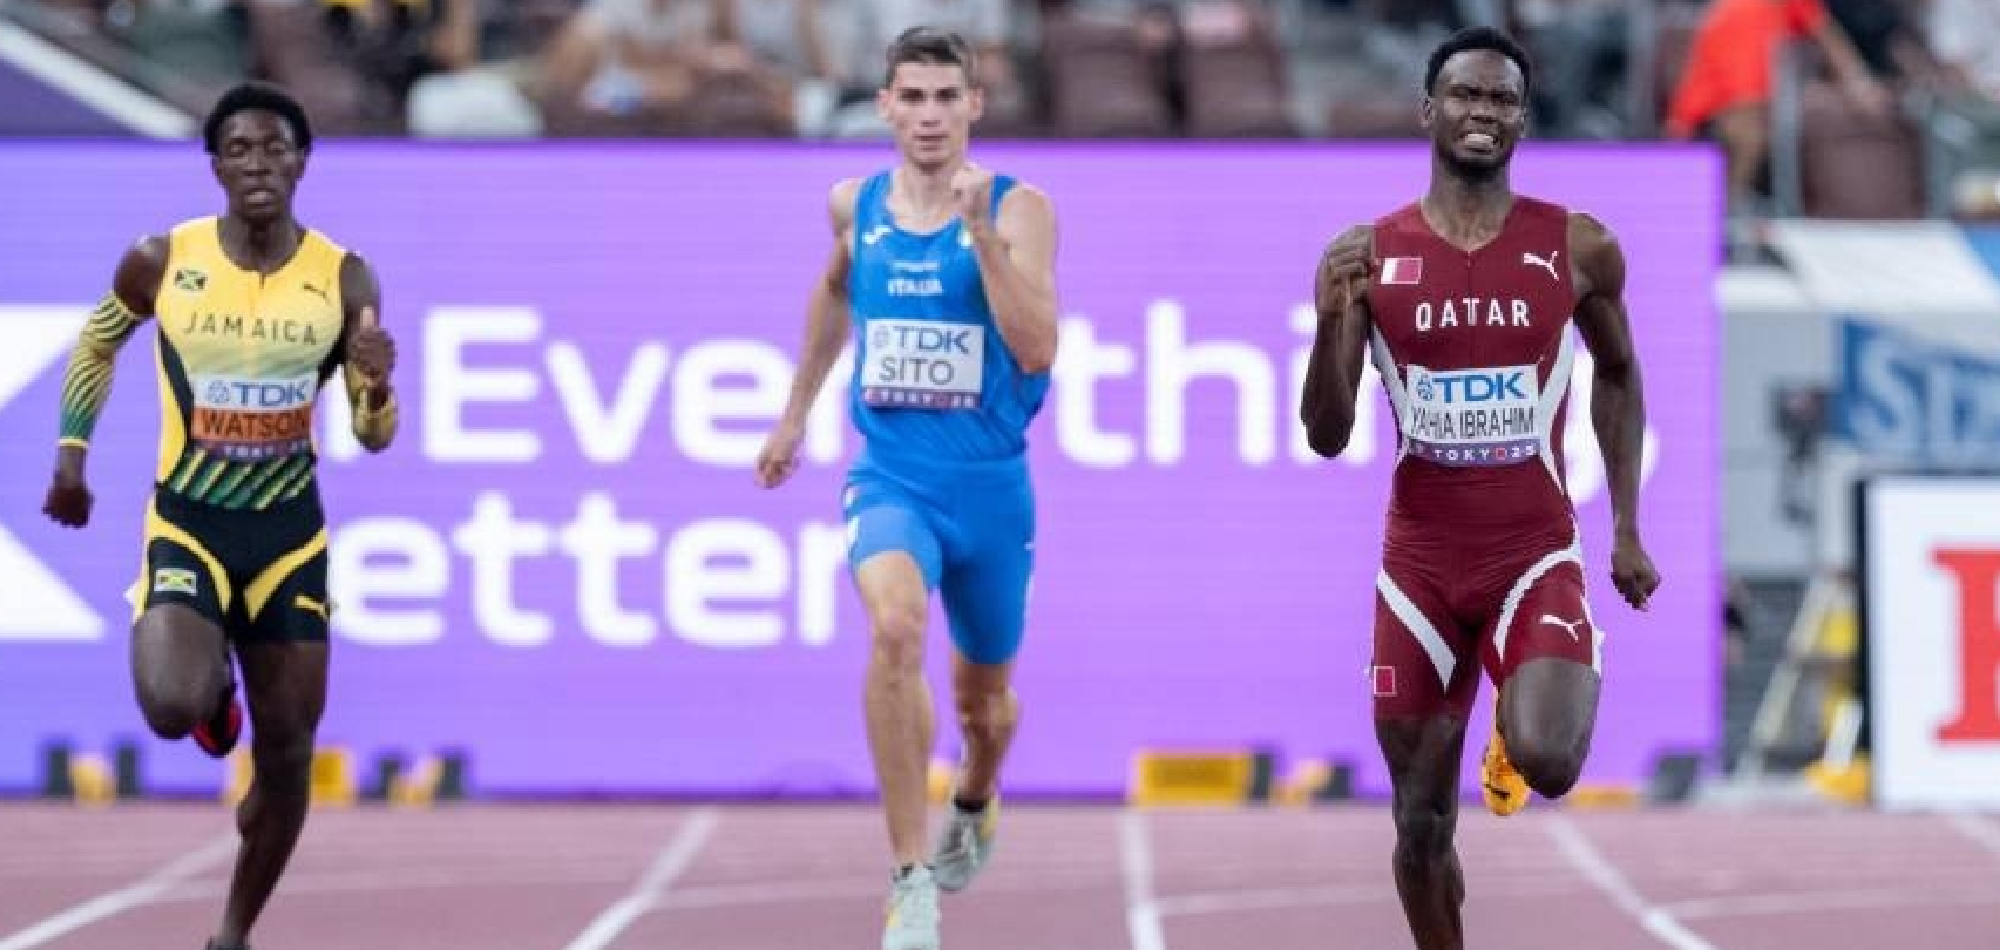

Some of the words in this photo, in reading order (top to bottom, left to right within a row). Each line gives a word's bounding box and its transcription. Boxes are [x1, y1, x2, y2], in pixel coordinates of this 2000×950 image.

[183, 311, 318, 346] JAMAICA
[1414, 297, 1531, 333] QATAR
[892, 325, 971, 354] TDK
[878, 356, 956, 386] SITO
[230, 380, 311, 407] TDK
[1431, 372, 1526, 404] TDK
[200, 408, 309, 438] WATSON
[1460, 405, 1535, 440] IBRAHIM
[330, 492, 853, 648] etter
